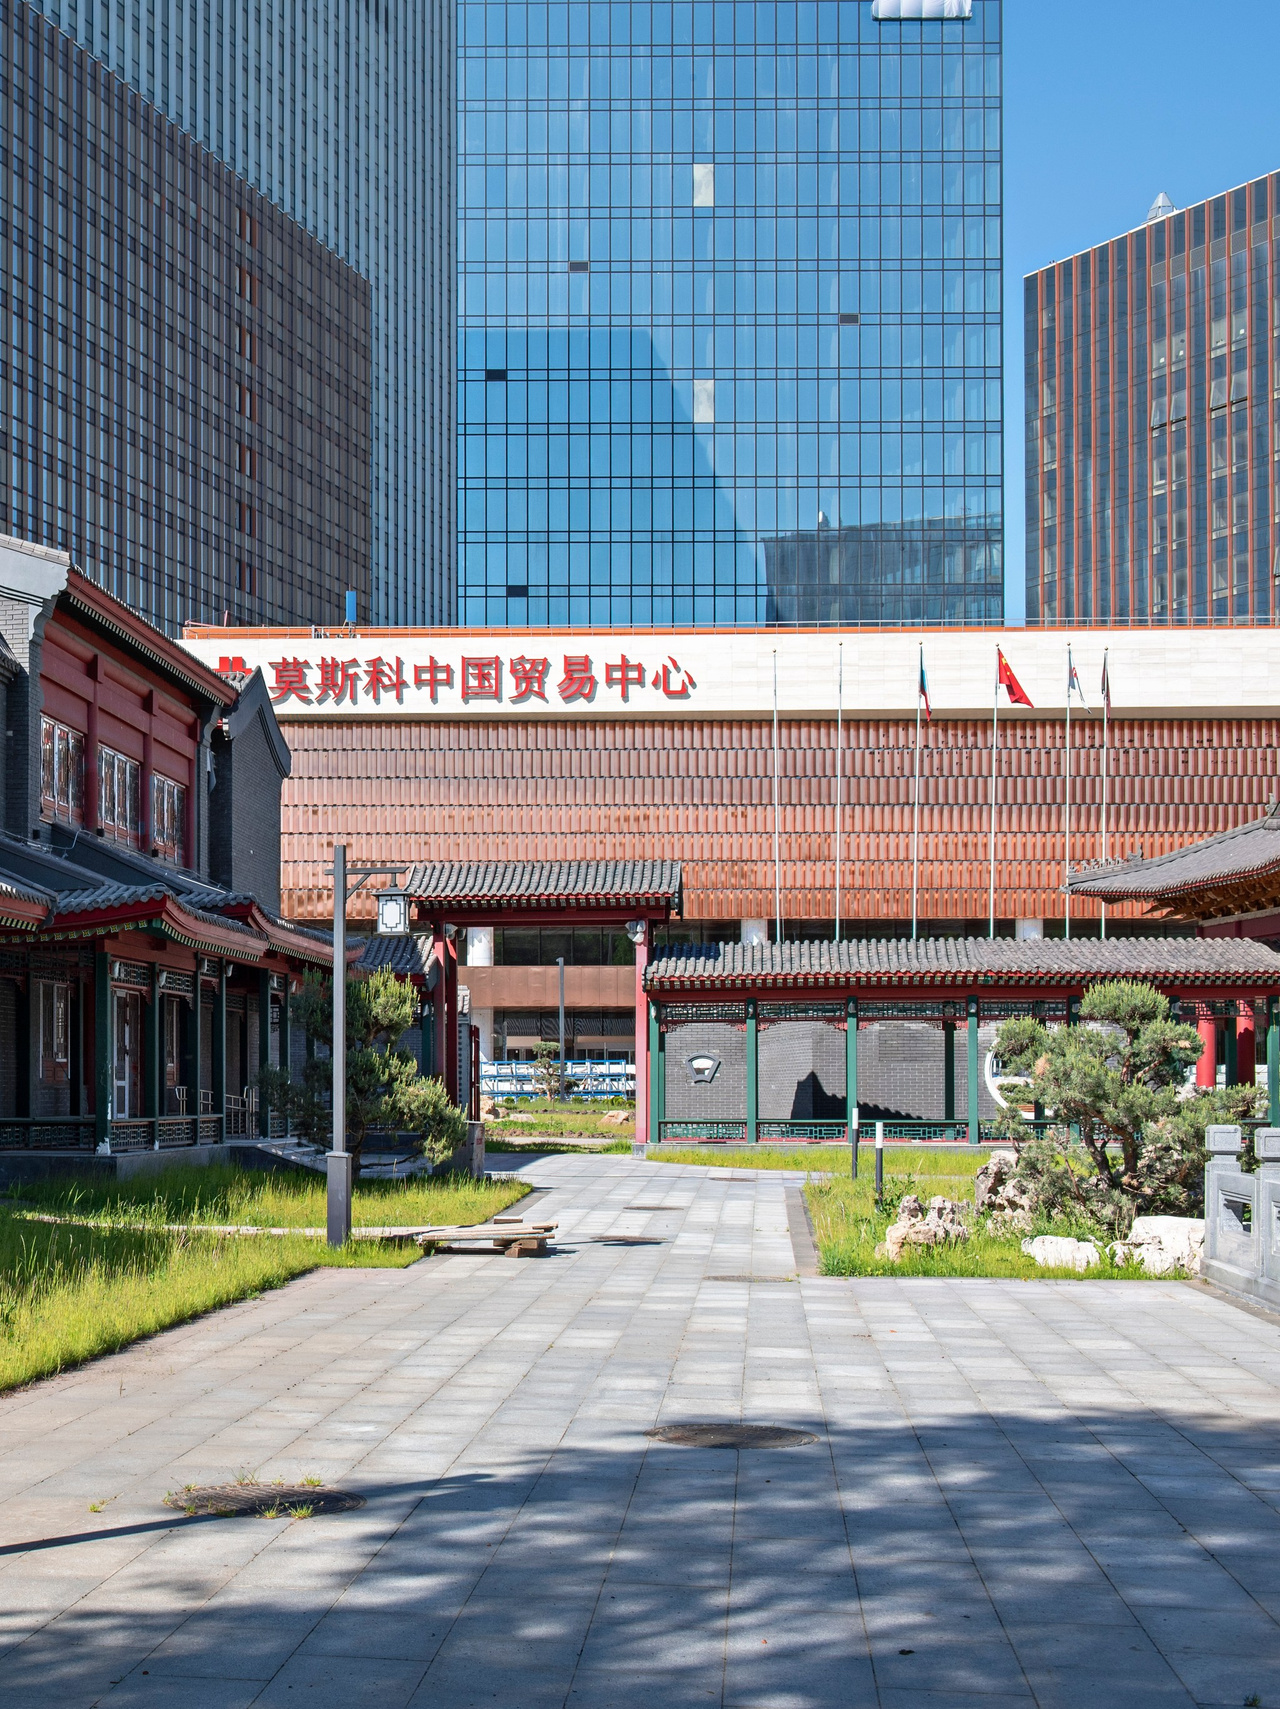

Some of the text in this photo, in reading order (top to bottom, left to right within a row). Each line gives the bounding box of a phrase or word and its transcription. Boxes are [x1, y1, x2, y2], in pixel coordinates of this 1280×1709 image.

[267, 655, 694, 701] 莫斯科中国贸易中心
